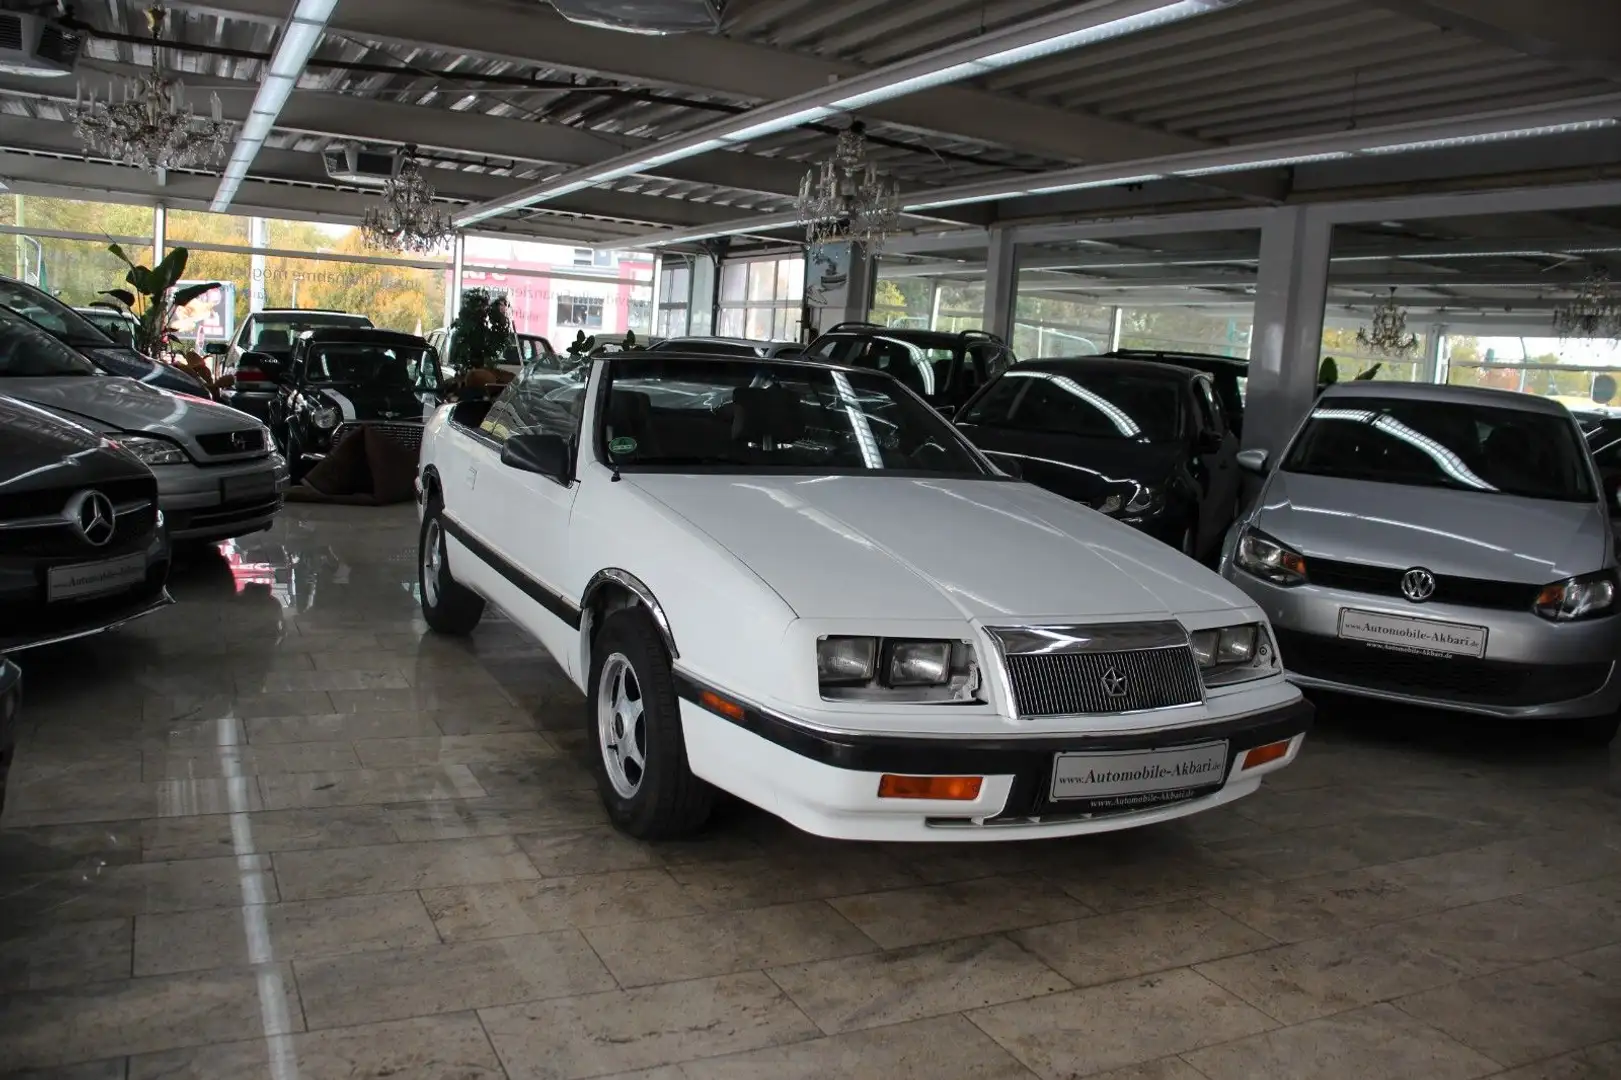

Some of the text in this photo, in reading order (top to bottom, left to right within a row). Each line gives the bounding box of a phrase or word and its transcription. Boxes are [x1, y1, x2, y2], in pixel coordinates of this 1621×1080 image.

[1345, 622, 1480, 647] www.Automobile-Akbari.de
[1058, 758, 1221, 785] www.Automobile-Akbari.de
[1090, 790, 1195, 808] www.Automobile-Akbari.de
